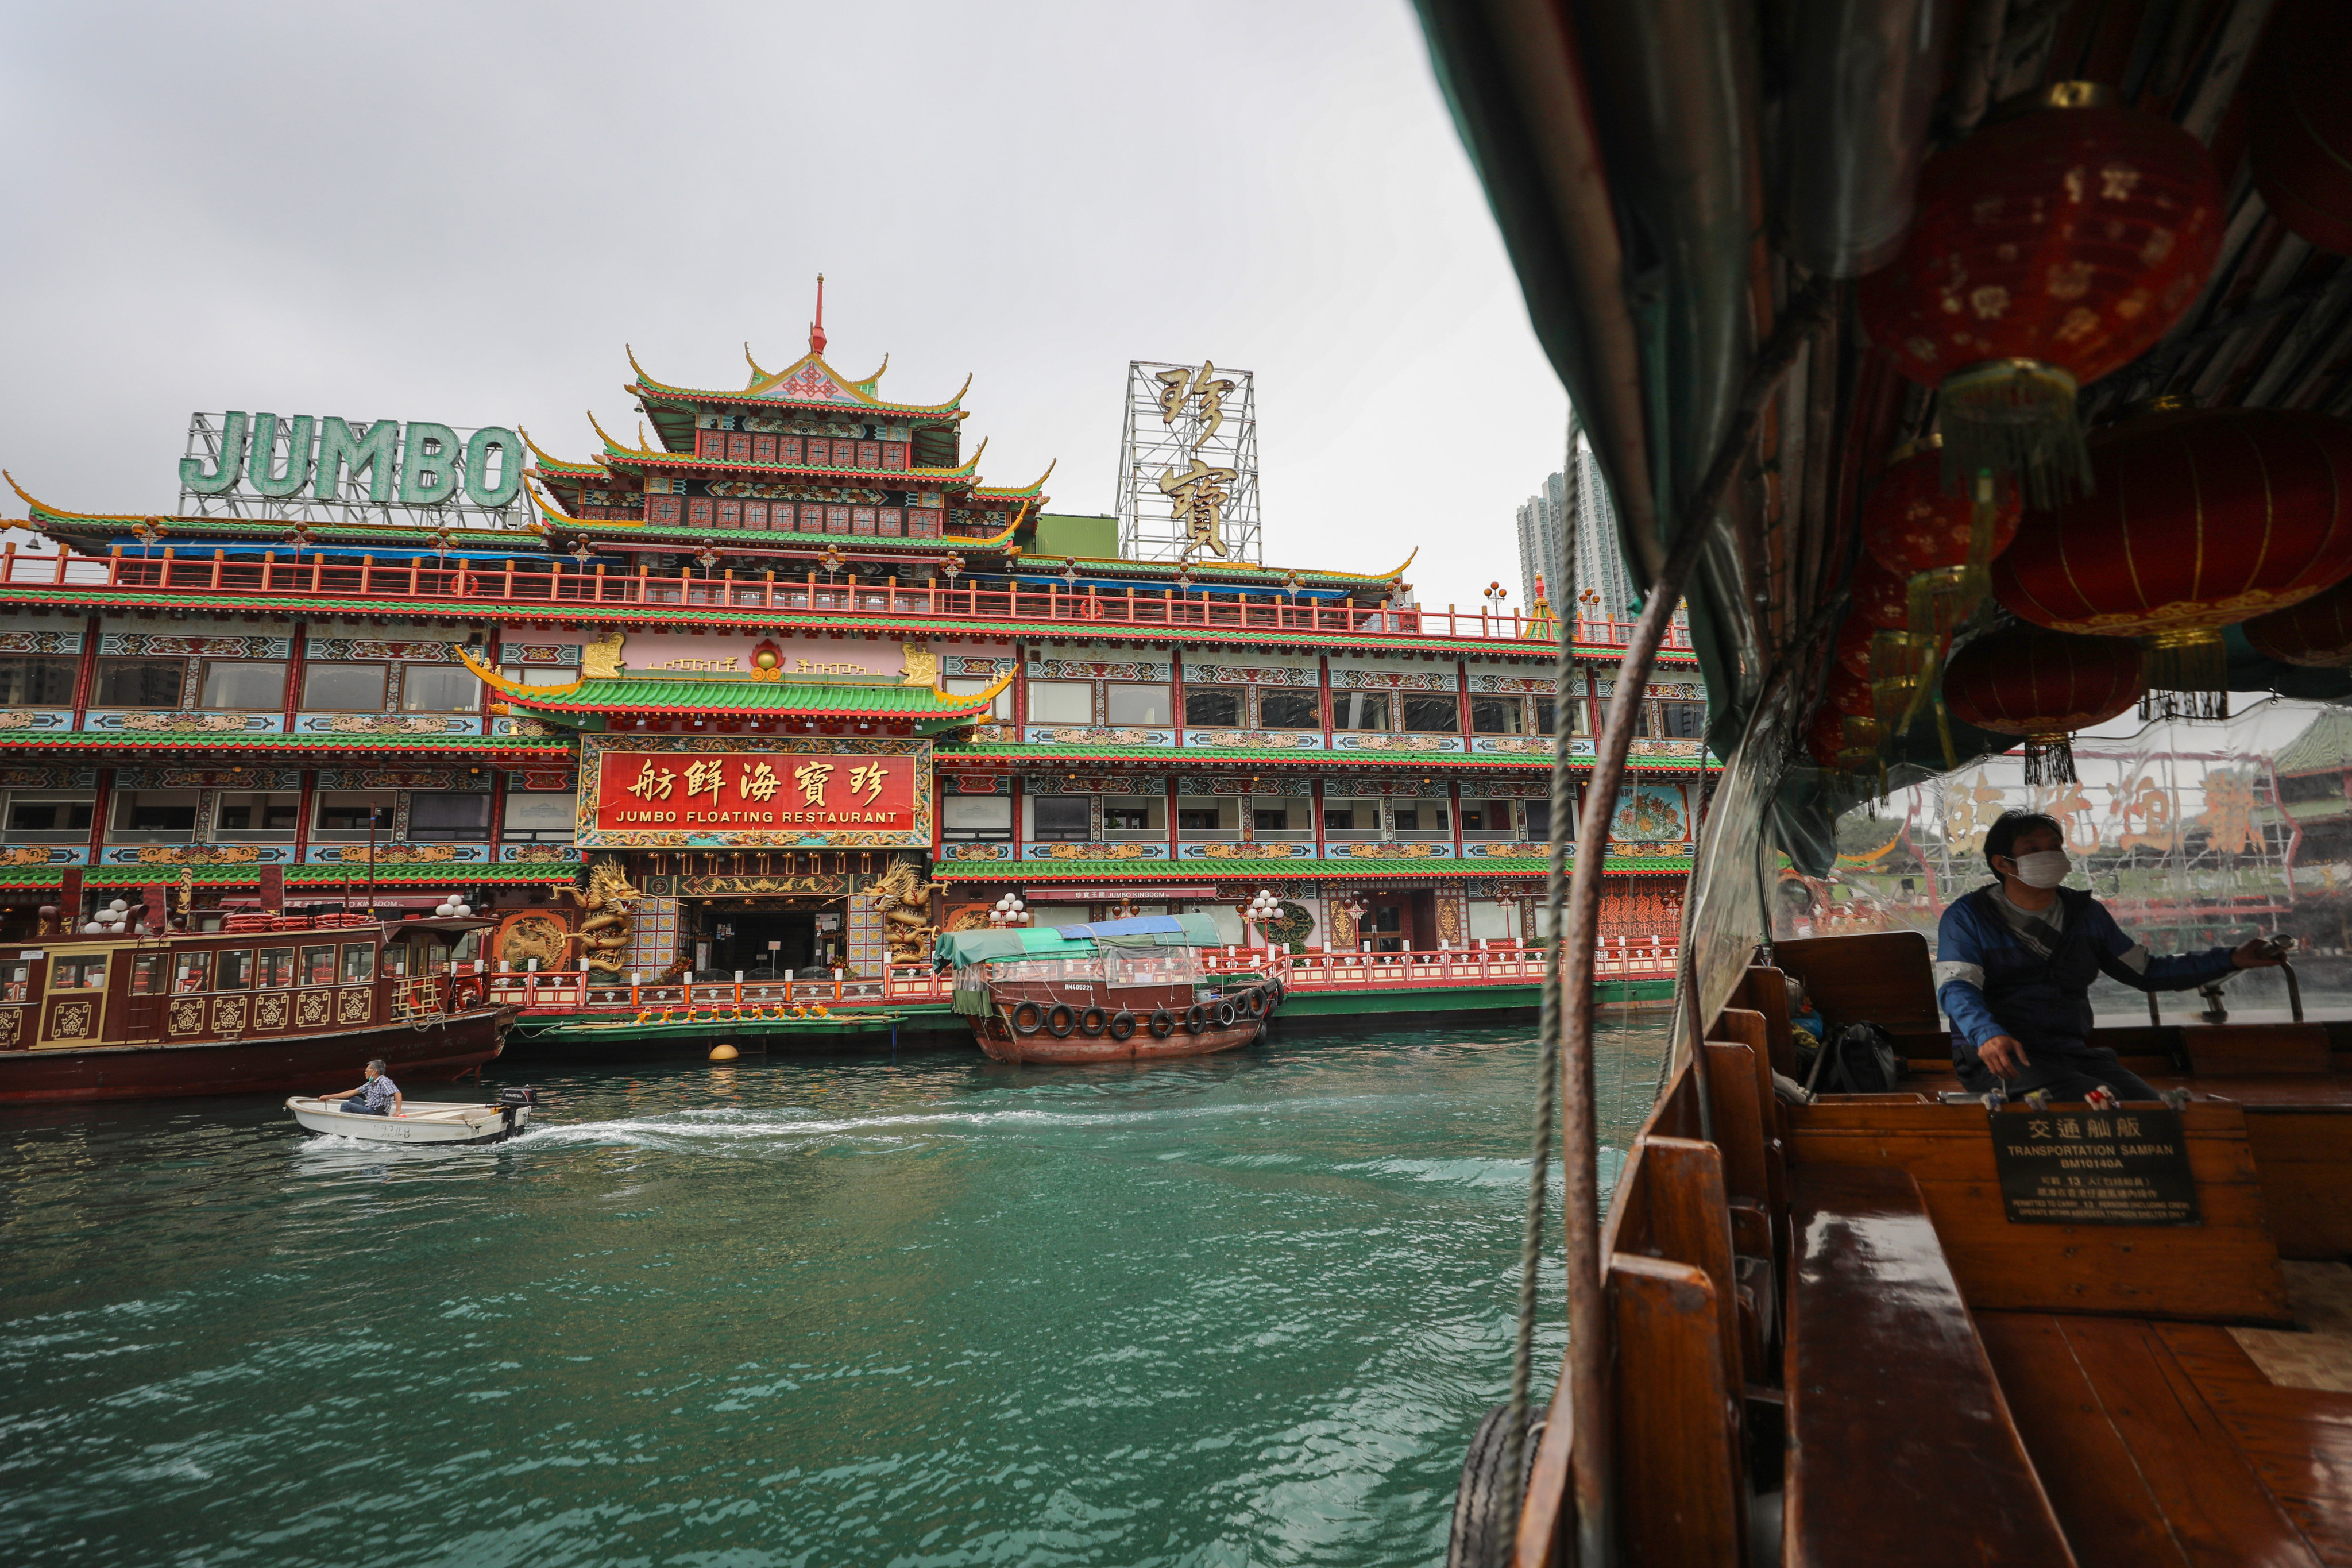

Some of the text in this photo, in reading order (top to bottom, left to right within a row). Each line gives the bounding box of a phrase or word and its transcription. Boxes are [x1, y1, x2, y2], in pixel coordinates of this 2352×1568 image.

[179, 411, 524, 508] JUMBO
[616, 810, 897, 823] JUMBO FLOATING RESTAURANT
[2007, 1144, 2174, 1156] TRANSPORTATION SAMPAN
[2060, 1158, 2124, 1169] BM10140A
[2067, 1176, 2081, 1186] 13
